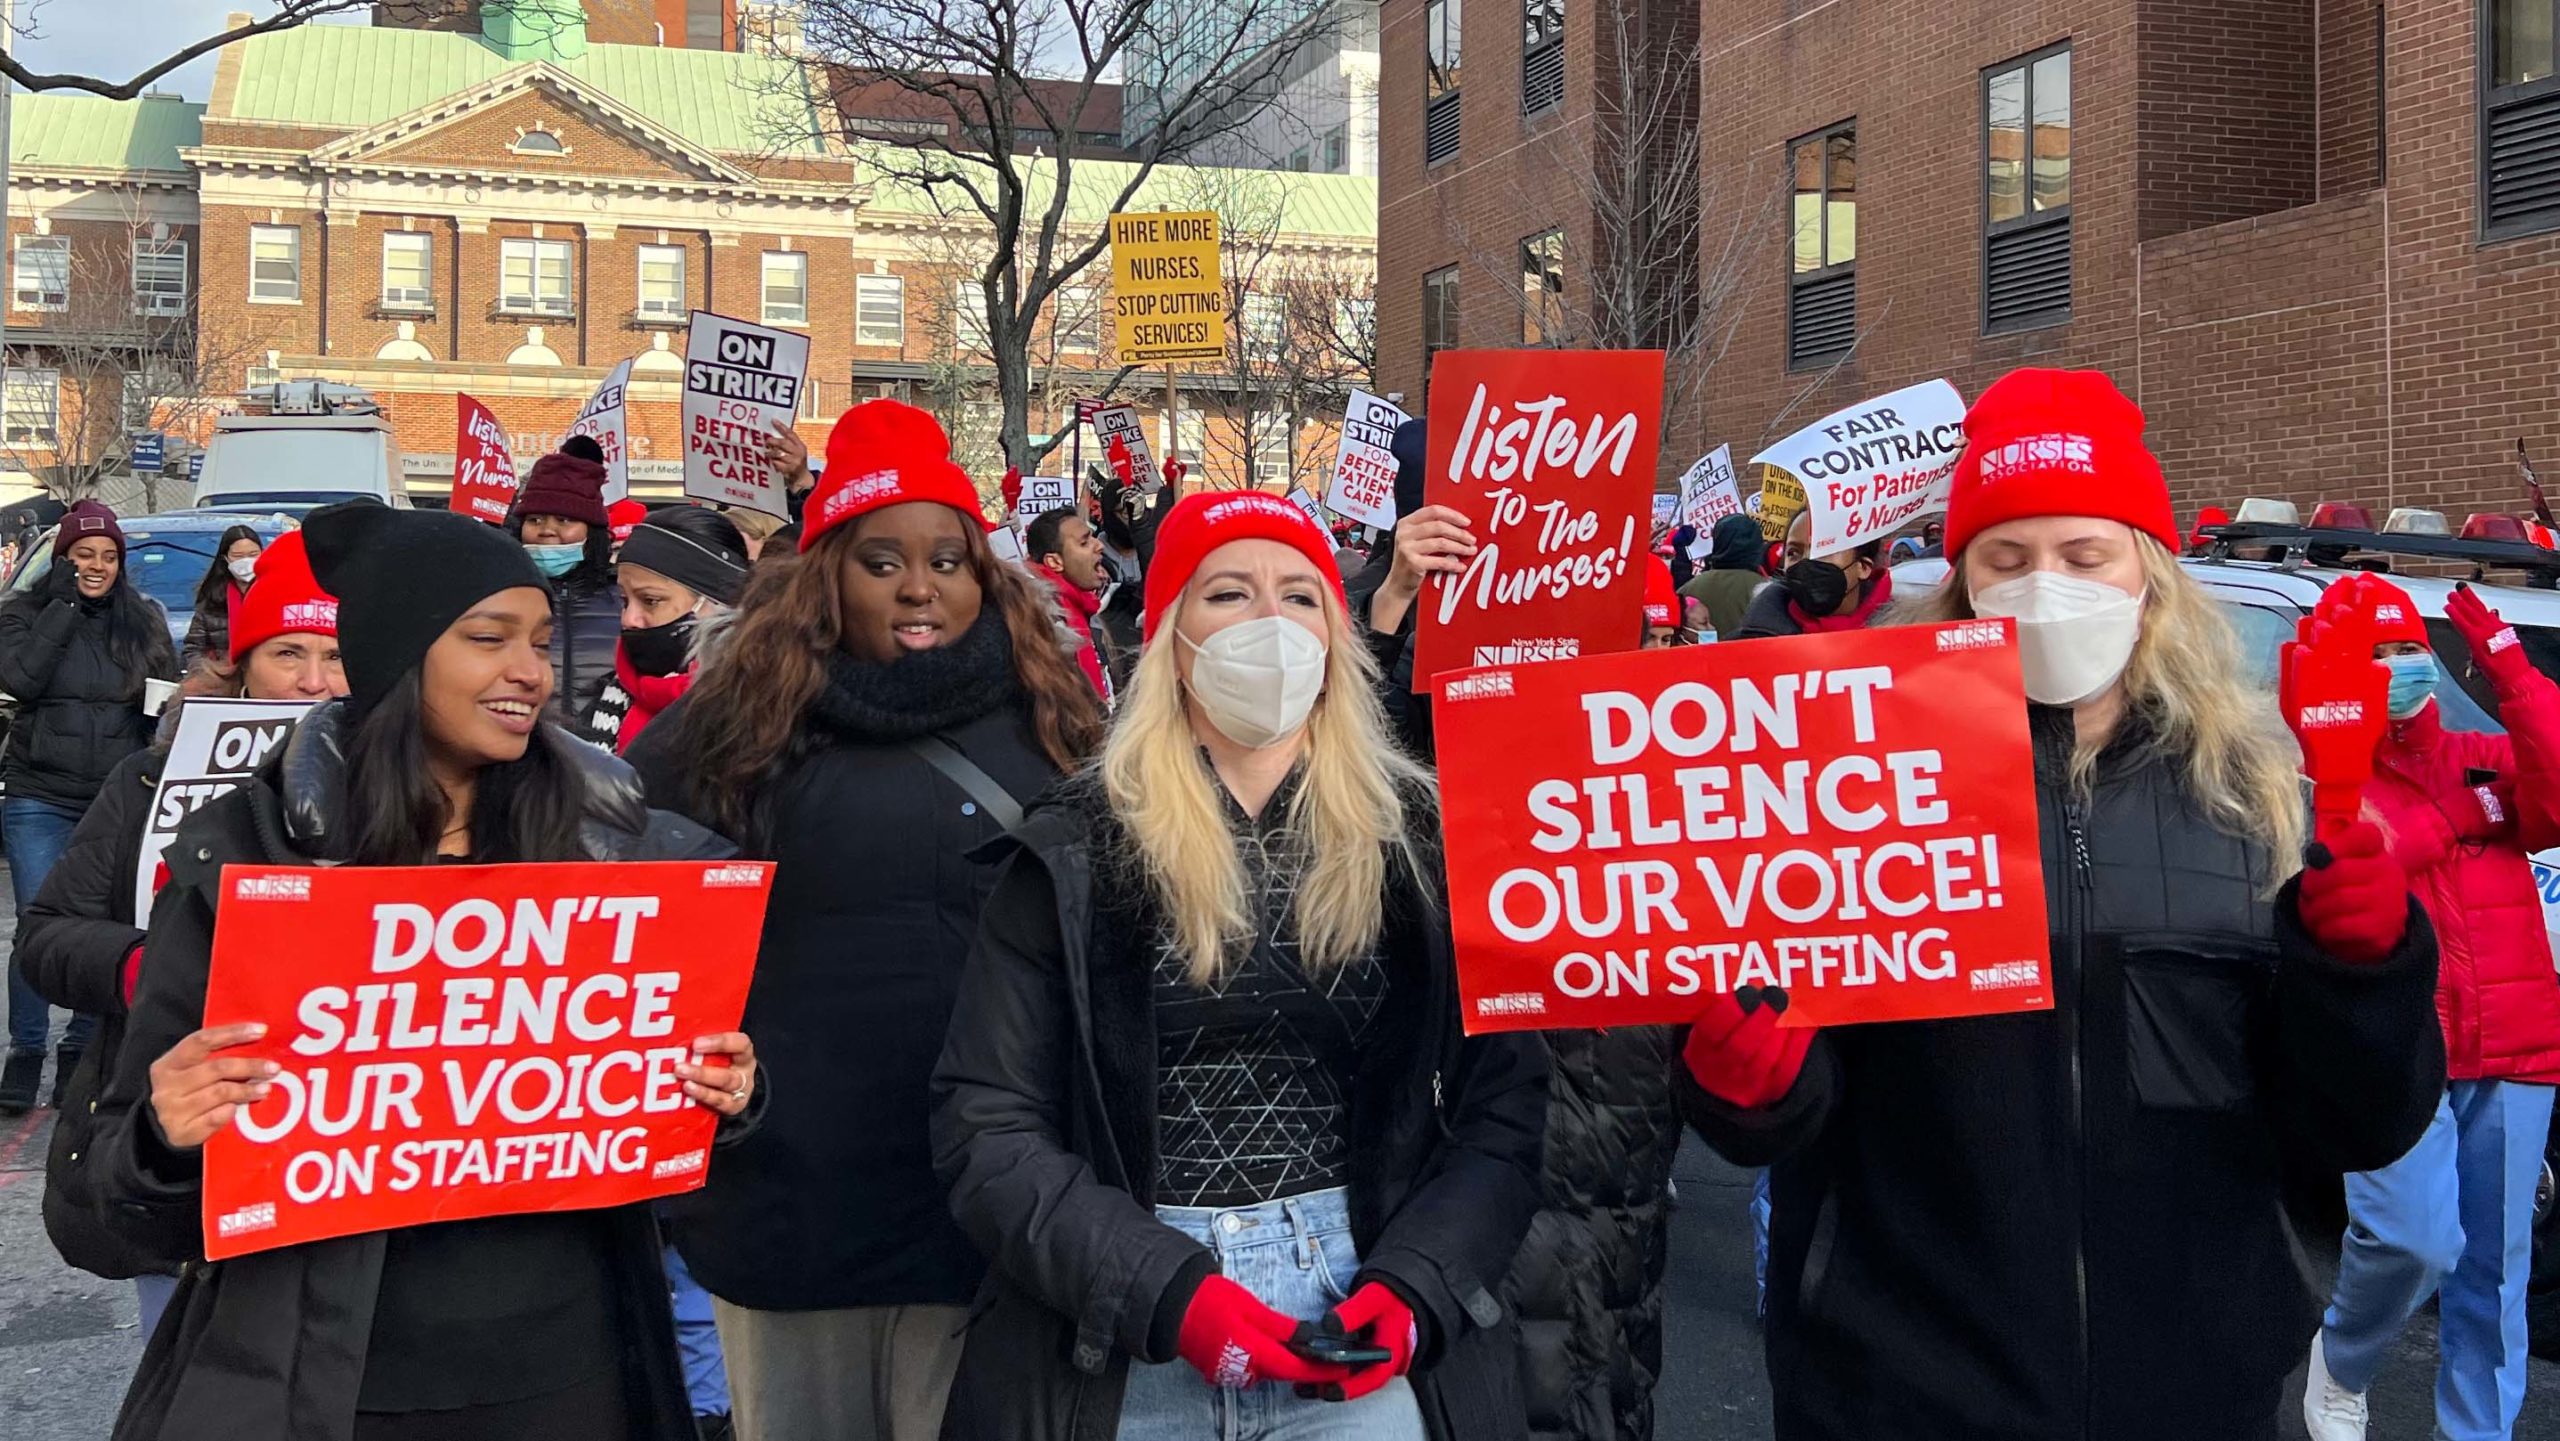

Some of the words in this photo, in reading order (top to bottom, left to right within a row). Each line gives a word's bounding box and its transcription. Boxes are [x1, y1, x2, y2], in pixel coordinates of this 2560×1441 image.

[1117, 221, 1159, 244] HIRE
[1165, 219, 1212, 241] MORE
[1131, 256, 1205, 281] NURSES,
[1117, 295, 1156, 316] STOP
[1160, 292, 1220, 314] CUTTING
[1134, 323, 1208, 345] SERVICES!
[721, 334, 770, 367] ON
[690, 362, 794, 406] STRIKE
[719, 399, 759, 425] FOR
[1106, 414, 1125, 430] ON
[1369, 405, 1396, 428] ON
[1821, 408, 1905, 443] FAIR
[1101, 428, 1141, 448] STIKE
[1347, 422, 1394, 450] STRI
[1449, 383, 1637, 483] listen
[691, 435, 770, 467] PATIEN
[1364, 446, 1390, 466] FOR
[1800, 422, 1964, 479] CONTRACT
[1980, 440, 2092, 477] NURSES
[708, 460, 770, 488] CARE
[1689, 466, 1729, 501] TRIKE
[1691, 461, 1712, 482] ON
[1827, 482, 1868, 510] For
[1873, 459, 1959, 501] Patients
[1982, 460, 2095, 486] ASSOCIATION
[824, 475, 899, 514] NURSES
[1034, 484, 1059, 496] ON
[1344, 486, 1382, 509] CARE
[1696, 489, 1718, 506] FOR
[1765, 480, 1776, 495] ON
[1778, 483, 1792, 499] THE
[1793, 487, 1804, 503] JOB
[1688, 494, 1733, 522] BETTER
[1692, 503, 1738, 530] ATIENT
[1846, 511, 1862, 538] &
[1864, 493, 1929, 533] Nurses
[1533, 500, 1598, 553] The
[1433, 515, 1635, 624] Nurses!
[283, 604, 337, 621] NURS
[283, 620, 336, 628] ASSOCIAT
[1512, 638, 1533, 647] New
[1535, 637, 1556, 647] York
[1557, 637, 1579, 646] State
[1936, 627, 2004, 646] NURSES
[1473, 645, 1579, 668] NURSES
[1446, 676, 1513, 697] NURSES
[1581, 665, 1892, 765] DON'T
[2301, 706, 2363, 723] NURSES
[214, 725, 286, 769] ON
[1527, 750, 1949, 853] SILENCE
[237, 879, 311, 895] NURSES
[1488, 860, 1688, 942] OUR
[1696, 835, 2003, 929] VOICE!
[372, 896, 659, 973] DON'T
[1554, 950, 1650, 998] ON
[1666, 929, 1957, 995] STAFFING
[1970, 966, 2039, 985] NURSES
[291, 972, 680, 1056] SILENCE
[1477, 997, 1544, 1011] NURSES
[236, 1063, 423, 1143] OUR
[286, 1145, 380, 1203] ON
[390, 1127, 648, 1190] STAFFING
